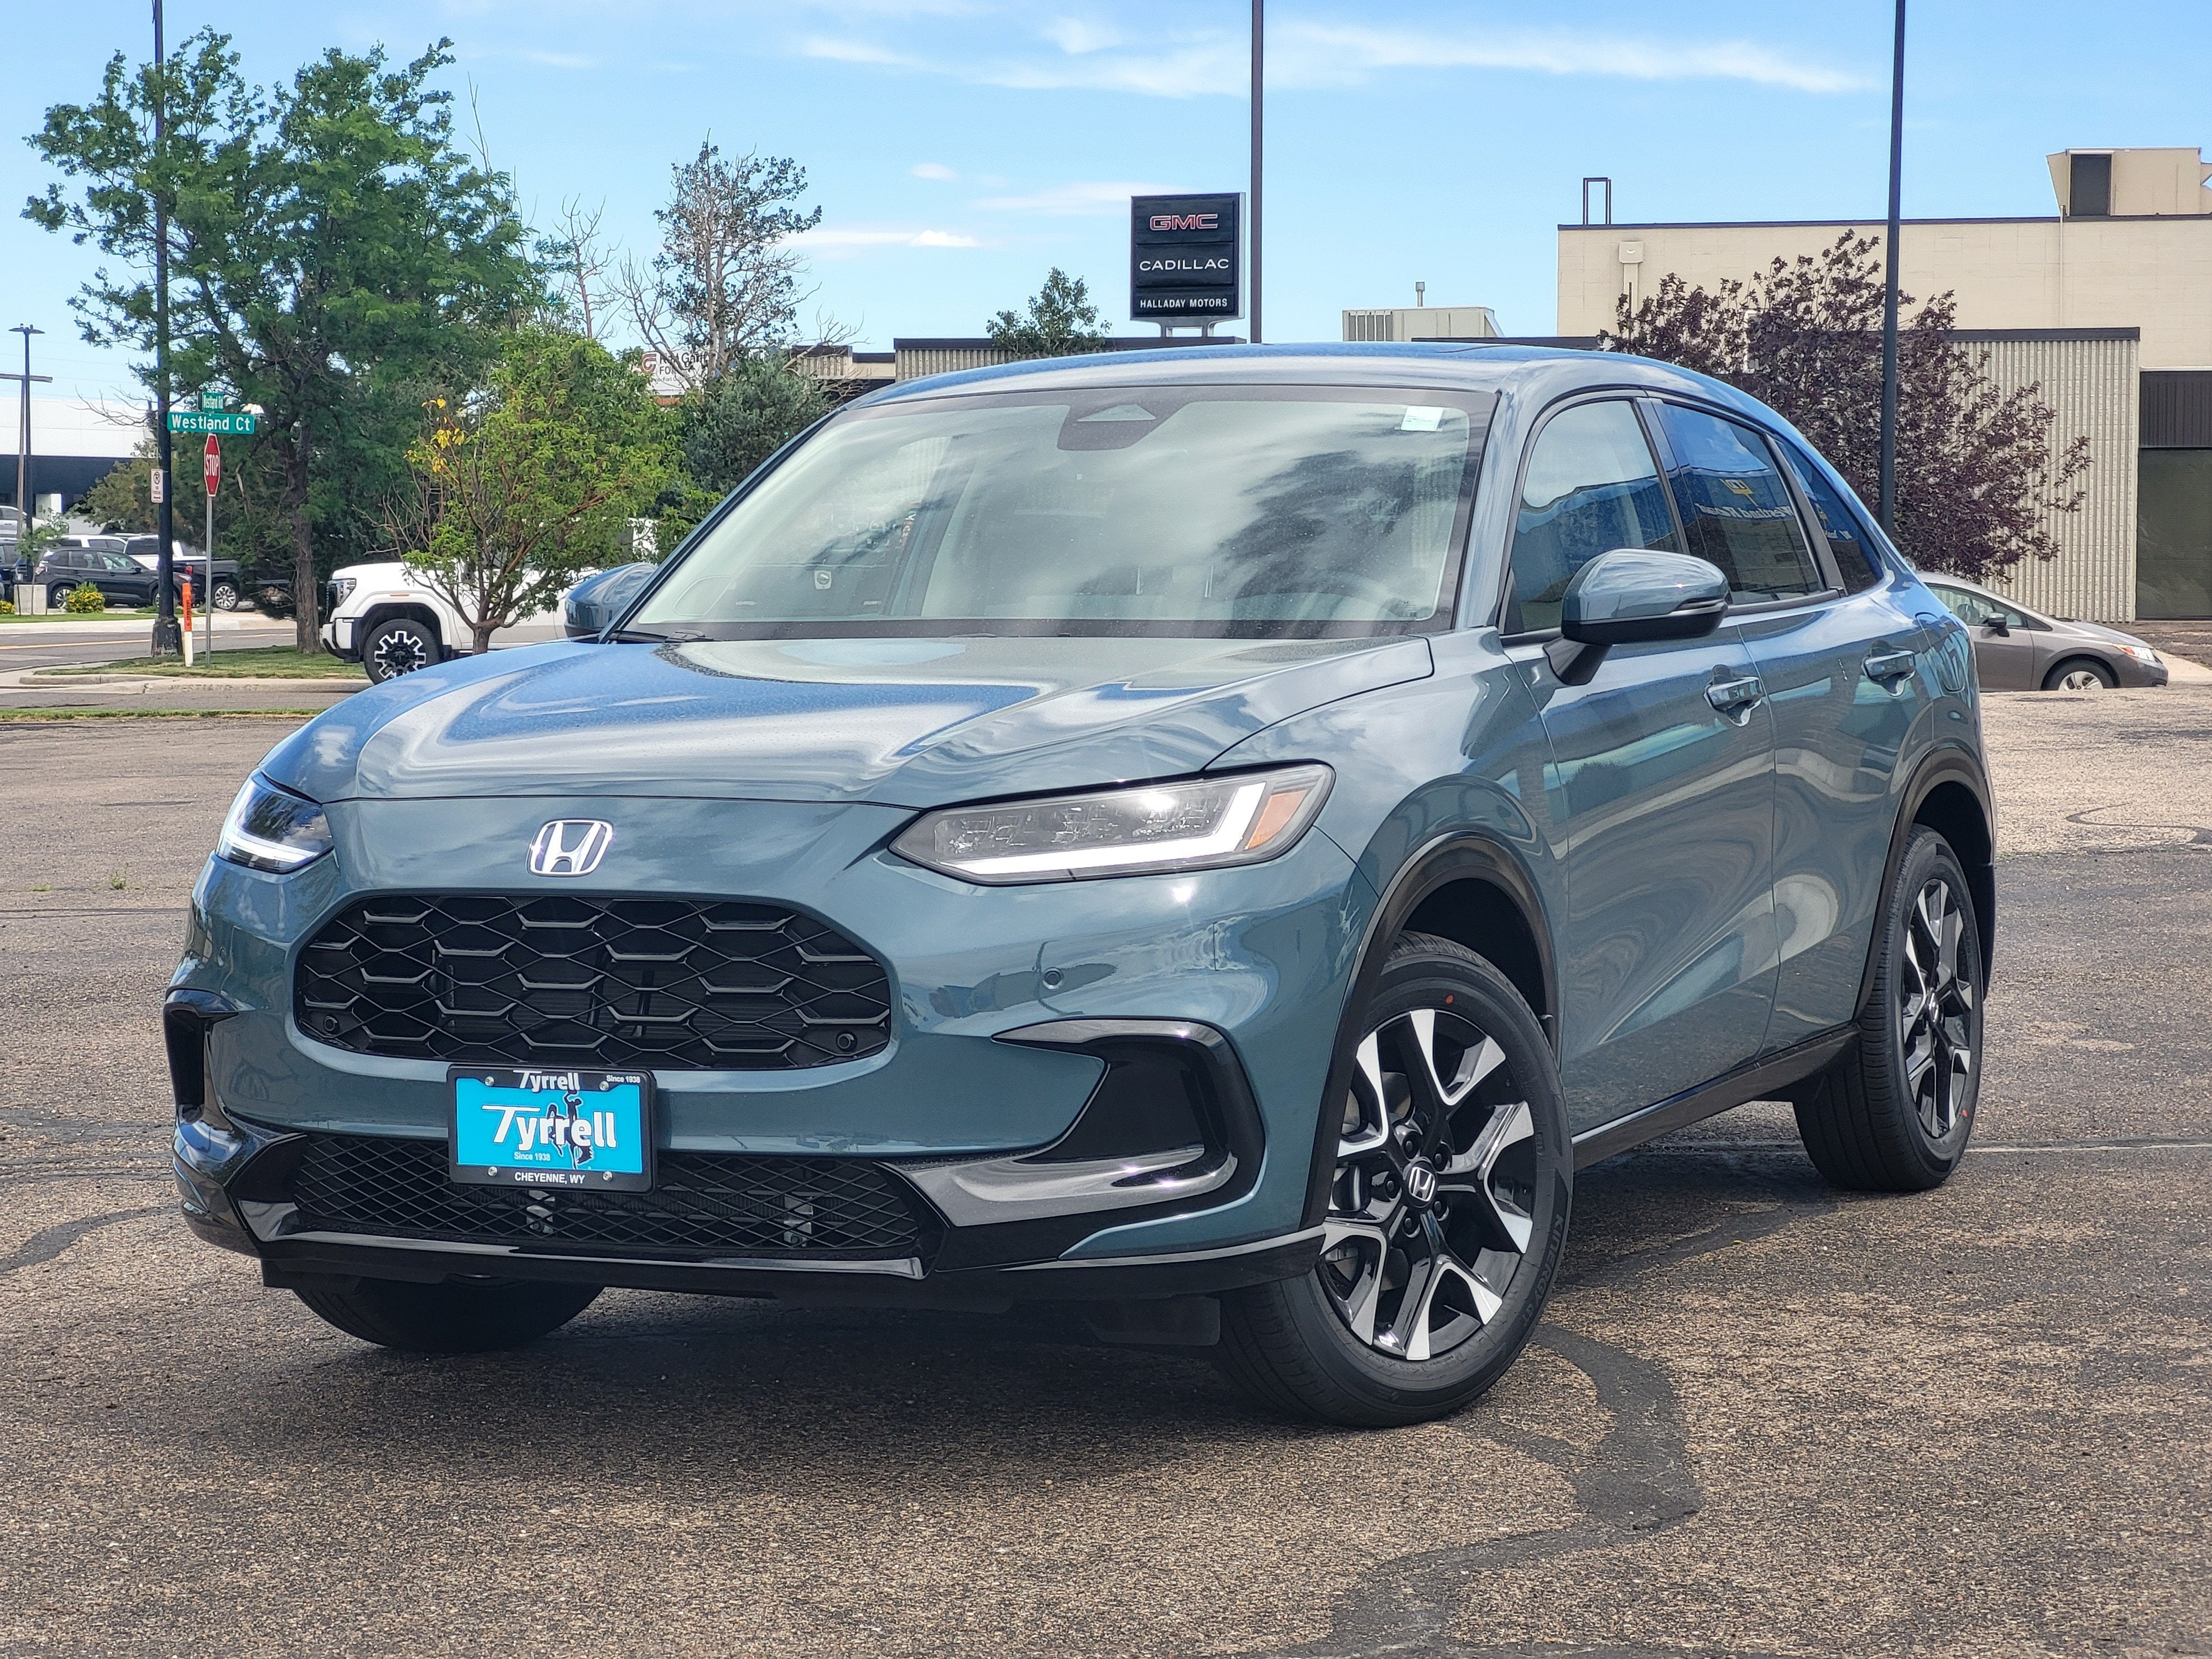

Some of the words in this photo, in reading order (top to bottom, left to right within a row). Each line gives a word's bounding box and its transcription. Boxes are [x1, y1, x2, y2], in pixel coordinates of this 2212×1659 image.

[1150, 214, 1218, 231] GMC
[1139, 258, 1229, 271] CADILLAC
[1140, 299, 1185, 308] HALLADAY
[1190, 298, 1228, 307] MOTORS
[171, 414, 229, 430] Westland
[236, 416, 251, 431] Ct
[206, 453, 218, 477] STOP
[513, 1070, 580, 1092] Tyrrell
[482, 1105, 617, 1151] Tyrrell
[514, 1151, 533, 1160] Since
[534, 1152, 550, 1161] 1938
[514, 1172, 567, 1185] CHEYENNE,
[569, 1174, 585, 1184] WY
